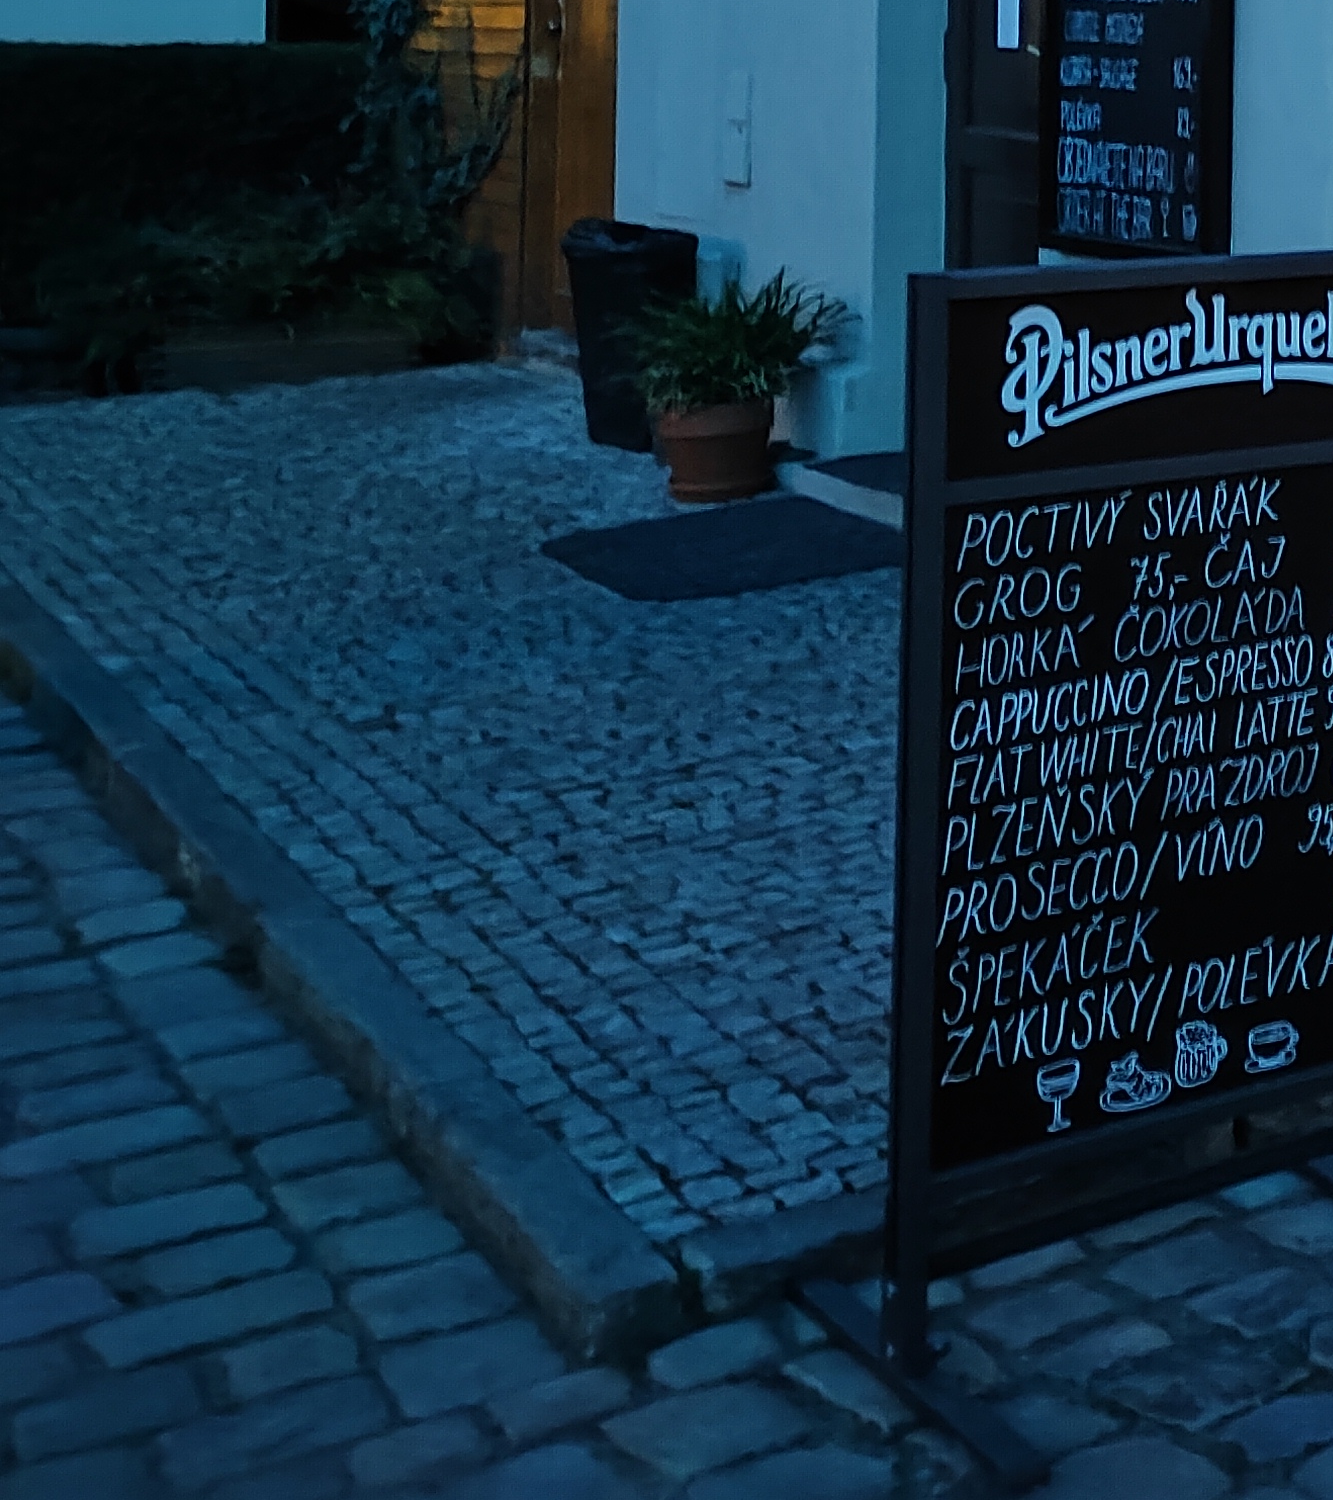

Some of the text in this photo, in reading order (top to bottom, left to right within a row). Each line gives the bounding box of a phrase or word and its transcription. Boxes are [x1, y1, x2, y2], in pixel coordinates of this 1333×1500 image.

[1001, 303, 1193, 448] Pilsner
[954, 562, 1083, 631] GROG
[1130, 552, 1190, 601] 75,-
[1204, 531, 1287, 589] ČAJ
[957, 489, 1134, 573] POCTIVÝ
[955, 614, 1096, 695] HORKÁ
[1114, 584, 1306, 663] ČOKOLÁDA
[948, 743, 1035, 810] FLAT
[1234, 687, 1319, 750] LATTE
[941, 767, 1156, 877] PLZEŇSKÝ
[1159, 741, 1320, 822] PRAZDROJ
[943, 906, 1160, 1026] ŠPEKÁČEK
